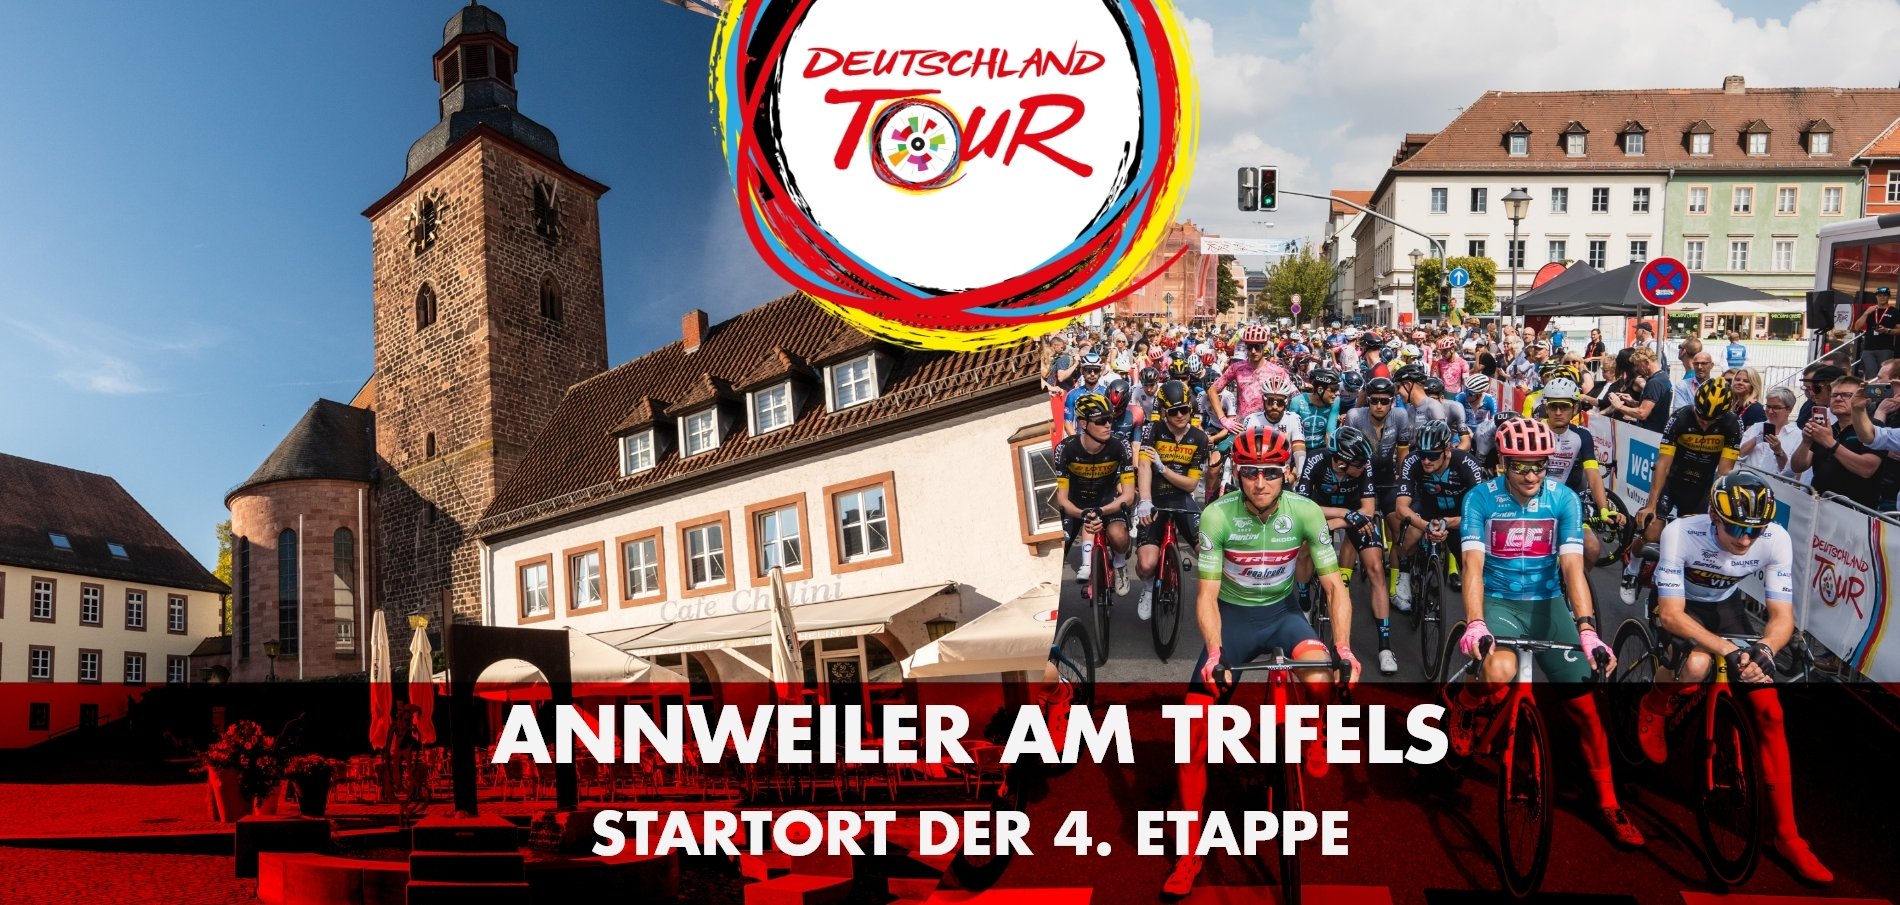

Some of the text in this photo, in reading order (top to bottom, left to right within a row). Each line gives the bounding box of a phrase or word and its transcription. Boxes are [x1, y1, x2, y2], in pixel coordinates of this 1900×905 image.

[1169, 445, 1193, 455] LOTTO
[1402, 454, 1420, 480] youfon
[1461, 455, 1482, 484] youfon
[1631, 452, 1655, 483] wei
[1232, 553, 1292, 563] TREK
[1692, 560, 1722, 570] Santini
[1731, 559, 1759, 567] DAUNER
[1812, 534, 1869, 573] DEUTSCHLAND
[732, 575, 844, 613] Chlini
[1812, 554, 1866, 620] TOUR
[797, 629, 847, 641] HELINI
